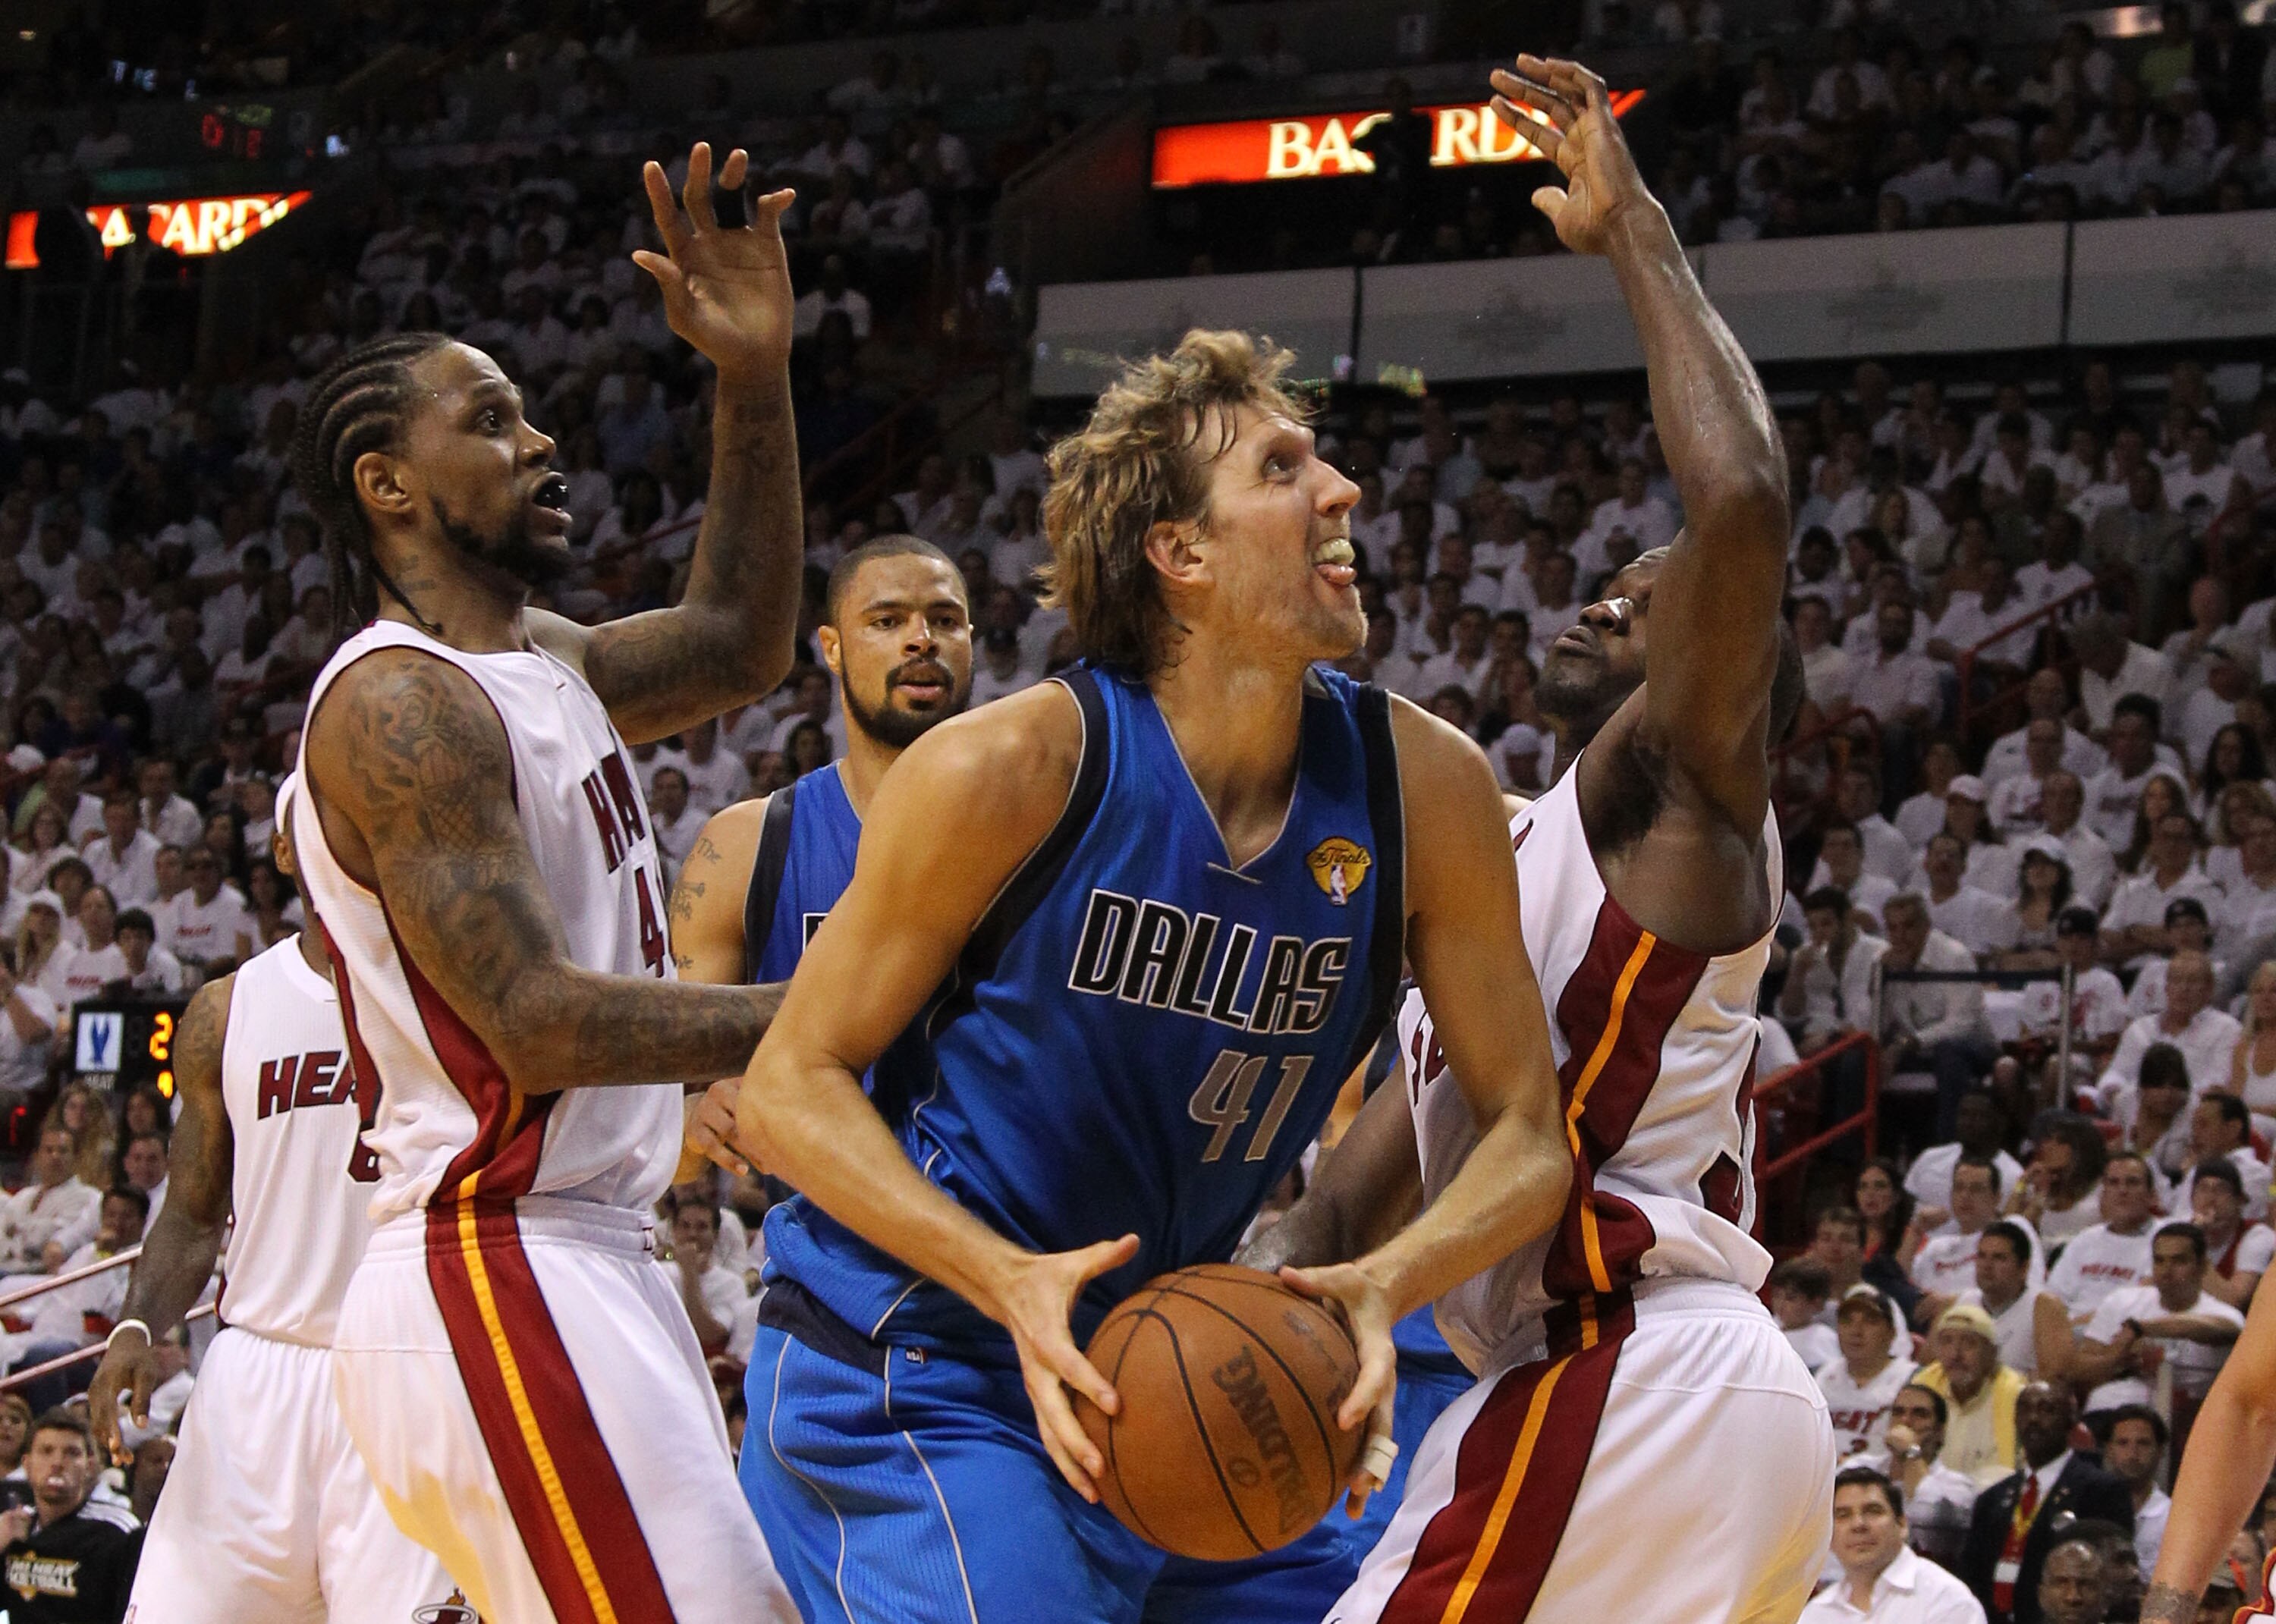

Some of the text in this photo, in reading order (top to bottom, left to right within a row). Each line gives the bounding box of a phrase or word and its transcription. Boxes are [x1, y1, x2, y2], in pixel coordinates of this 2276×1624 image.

[635, 865, 668, 978] 4
[1067, 888, 1353, 1035] DALLAS
[1188, 1049, 1315, 1163] 41
